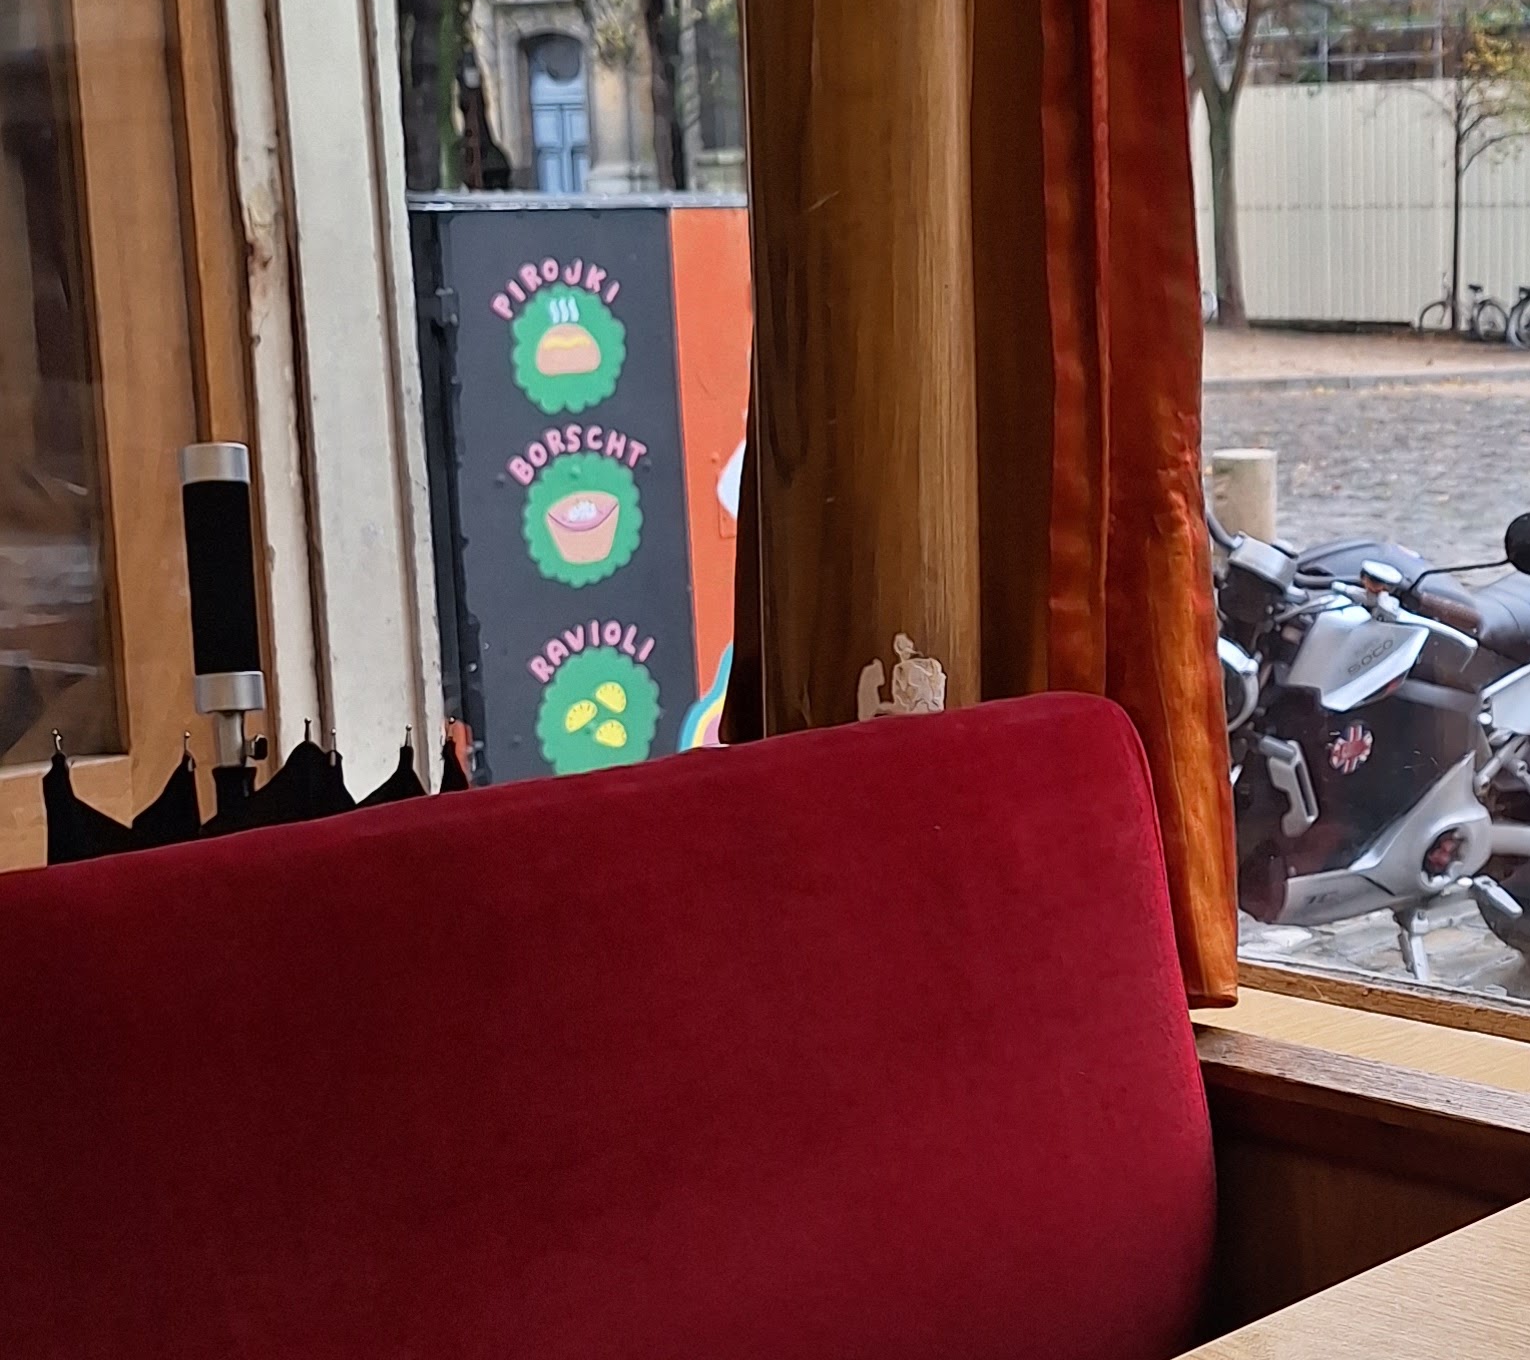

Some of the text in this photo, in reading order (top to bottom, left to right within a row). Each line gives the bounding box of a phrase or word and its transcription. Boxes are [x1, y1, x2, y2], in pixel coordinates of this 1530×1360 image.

[490, 256, 621, 320] PIROJKI
[507, 424, 648, 486] BORSCHT
[528, 618, 656, 683] RAVIOLI
